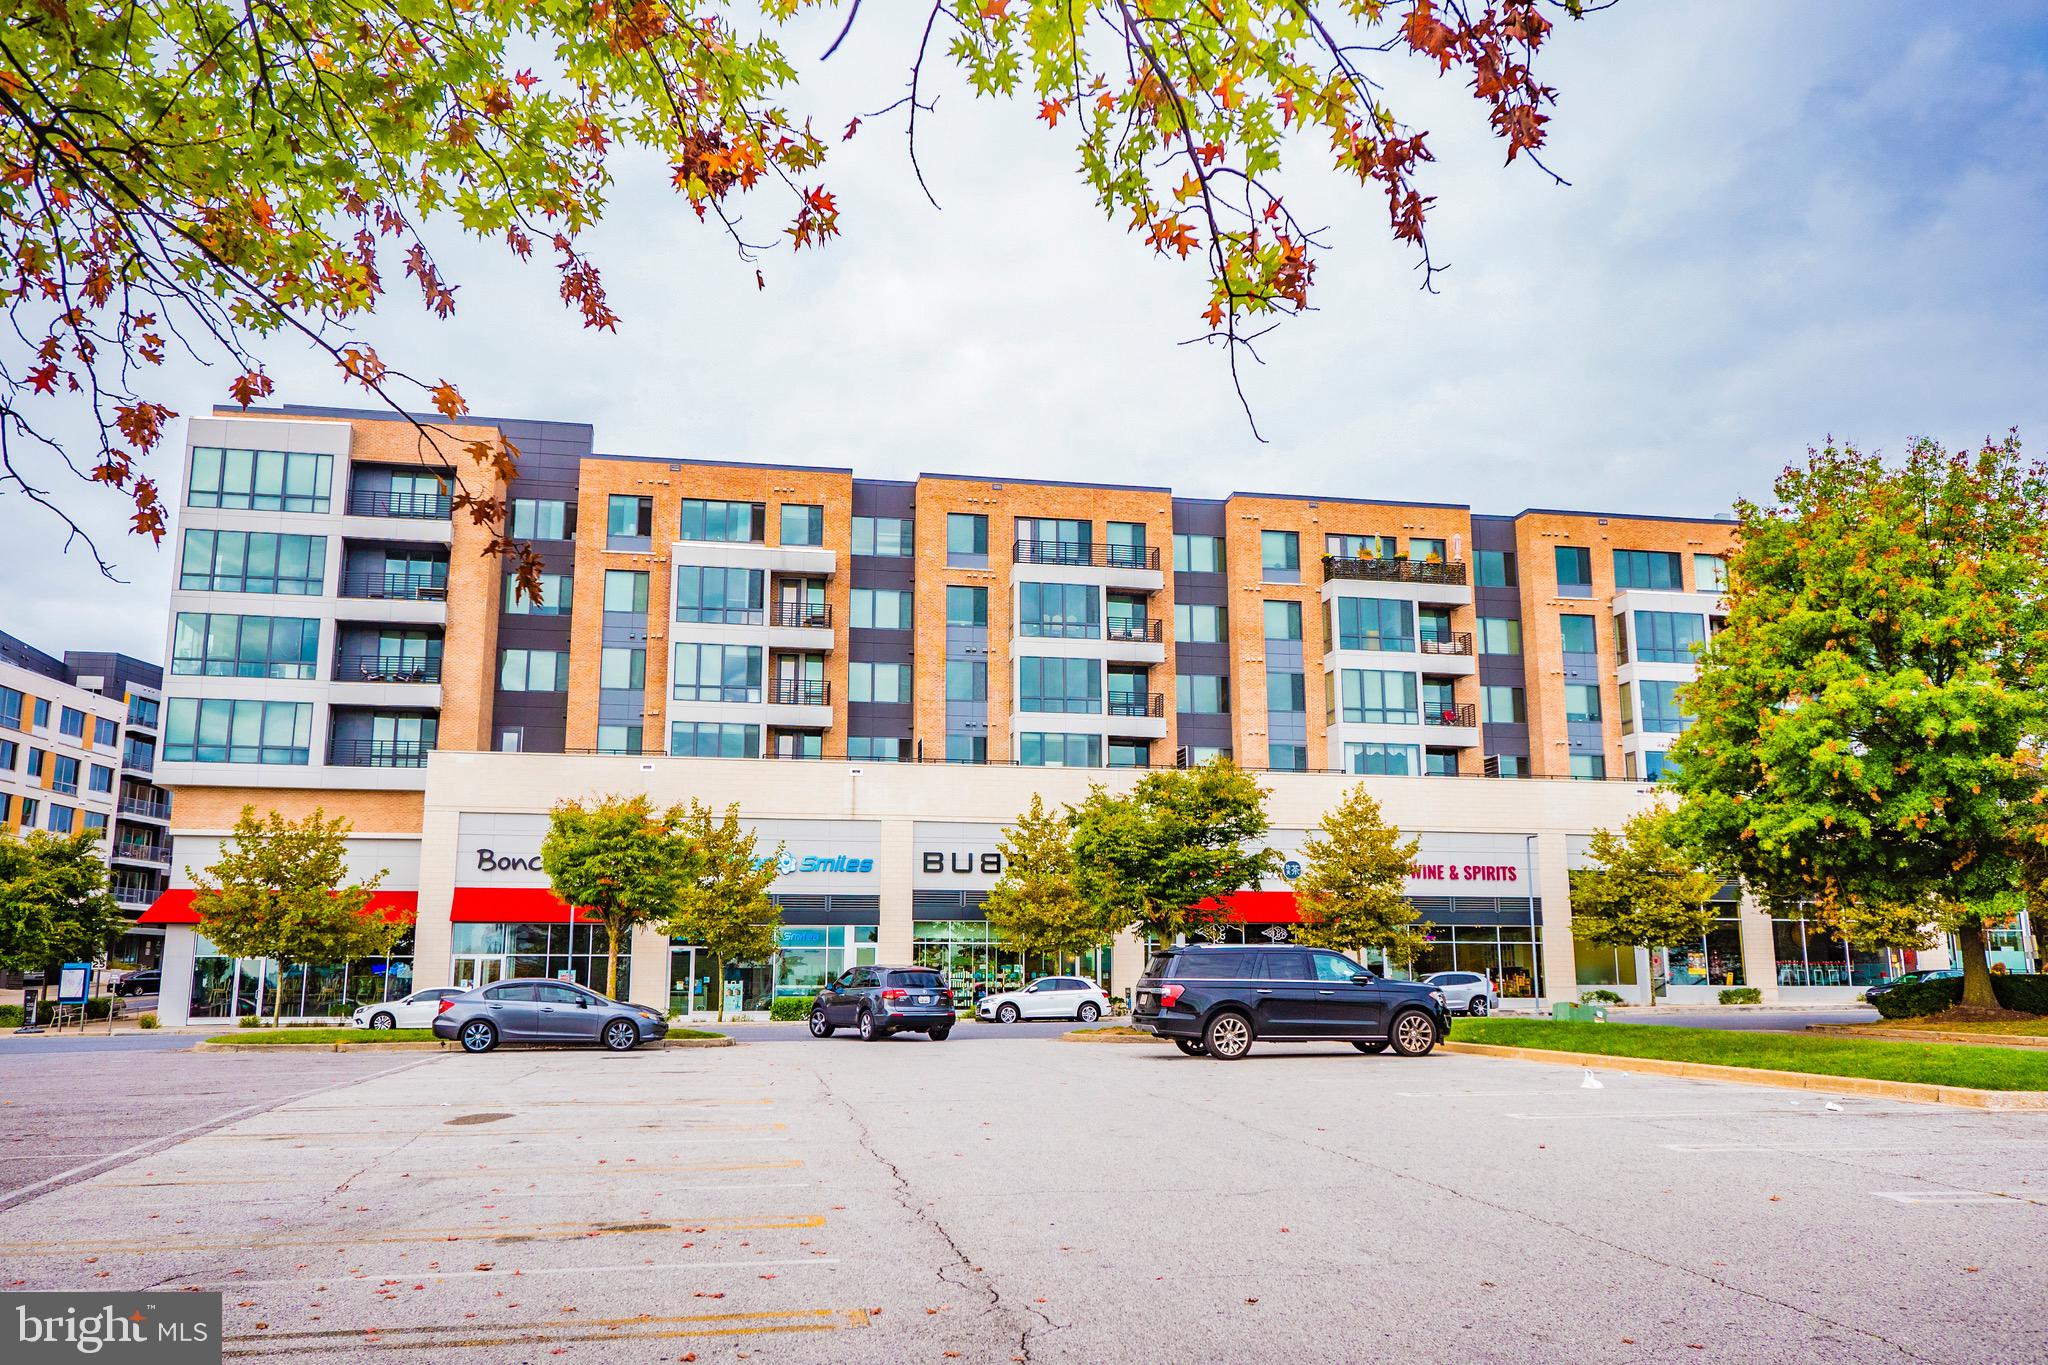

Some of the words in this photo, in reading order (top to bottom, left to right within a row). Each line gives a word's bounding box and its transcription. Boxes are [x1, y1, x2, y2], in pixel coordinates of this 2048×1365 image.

[476, 848, 543, 872] Bonc
[800, 853, 874, 873] Smiles
[923, 851, 1028, 873] BUB
[1449, 864, 1460, 880] &
[1463, 865, 1518, 881] SPIRITS
[92, 960, 105, 968] 25
